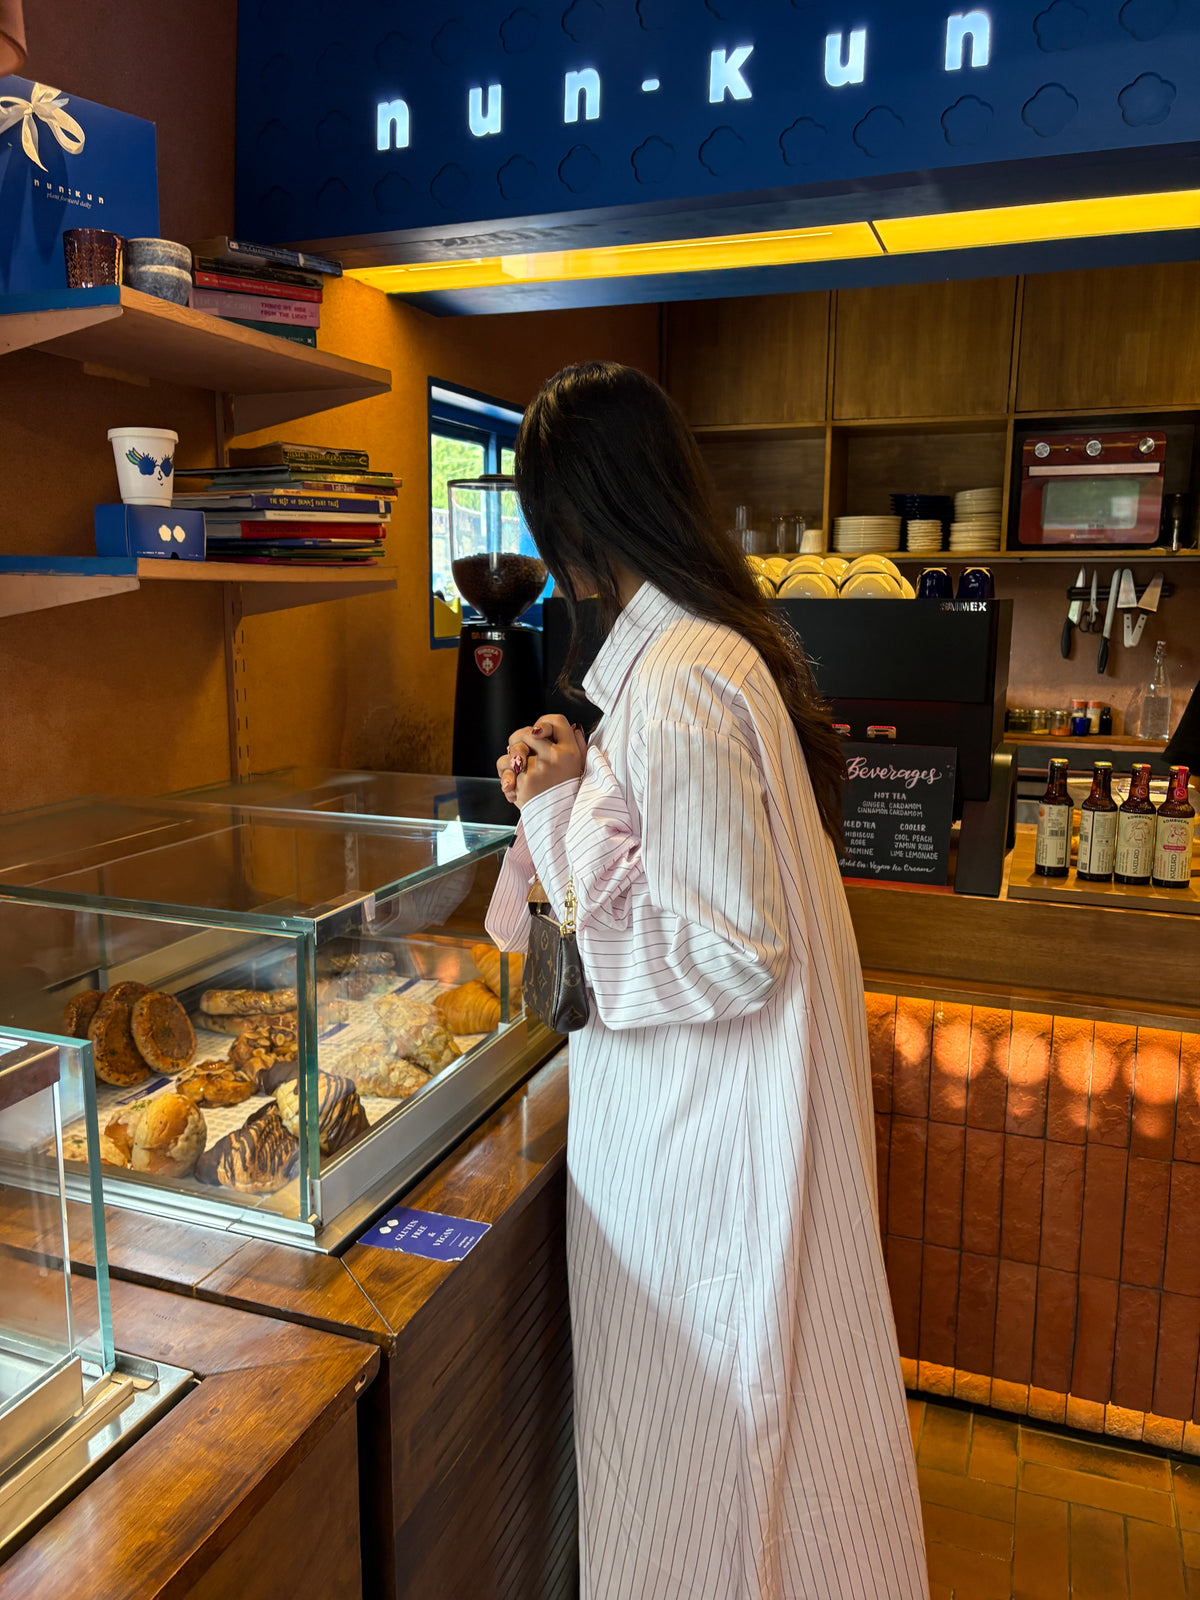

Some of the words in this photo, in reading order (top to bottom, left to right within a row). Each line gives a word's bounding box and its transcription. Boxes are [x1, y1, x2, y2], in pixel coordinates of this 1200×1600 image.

[843, 756, 943, 789] Beverages
[874, 792, 890, 800] HOT
[892, 792, 907, 801] TEA
[862, 800, 886, 808] GINGER
[889, 802, 922, 810] CARDAMOM
[857, 807, 888, 815] CINNAMON
[889, 808, 923, 818] CARDAMOM
[843, 820, 861, 829] ICED
[863, 821, 876, 830] TEA
[899, 823, 927, 832] COOLER
[845, 831, 875, 839] HIBISCUS
[894, 833, 910, 841] COOL
[912, 834, 933, 843] PEACH
[894, 842, 917, 850] JAMUN
[918, 843, 934, 851] RUSH
[905, 851, 939, 860] LEMONADE
[869, 860, 891, 874] Vegan
[903, 864, 936, 873] Cream
[395, 1219, 419, 1241] GLUTEN
[411, 1225, 429, 1239] FREE
[432, 1227, 455, 1246] VEGAN
